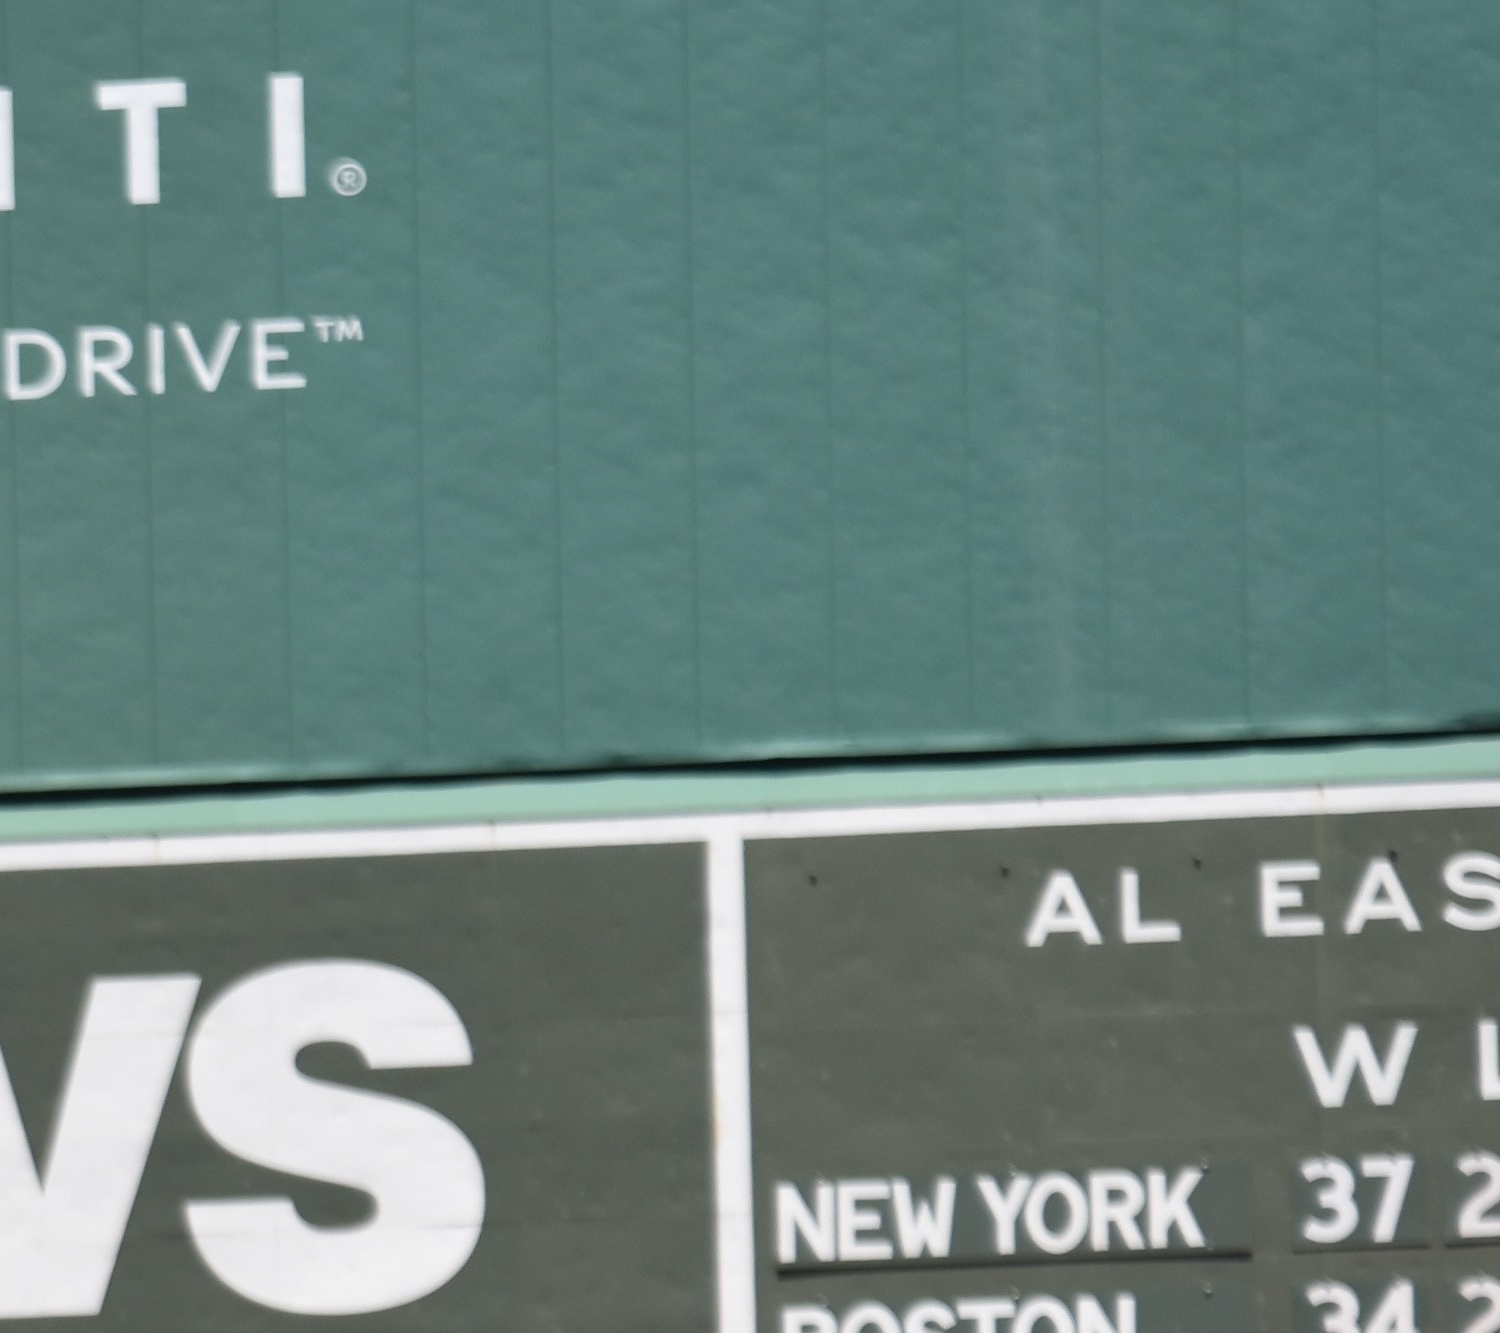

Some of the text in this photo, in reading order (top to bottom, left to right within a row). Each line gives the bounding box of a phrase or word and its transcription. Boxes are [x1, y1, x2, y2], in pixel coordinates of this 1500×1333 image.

[1024, 868, 1182, 949] AL
[1292, 1022, 1419, 1109] W
[774, 1177, 957, 1264] NEW
[975, 1167, 1206, 1256] YORK
[1299, 1153, 1415, 1244] 37
